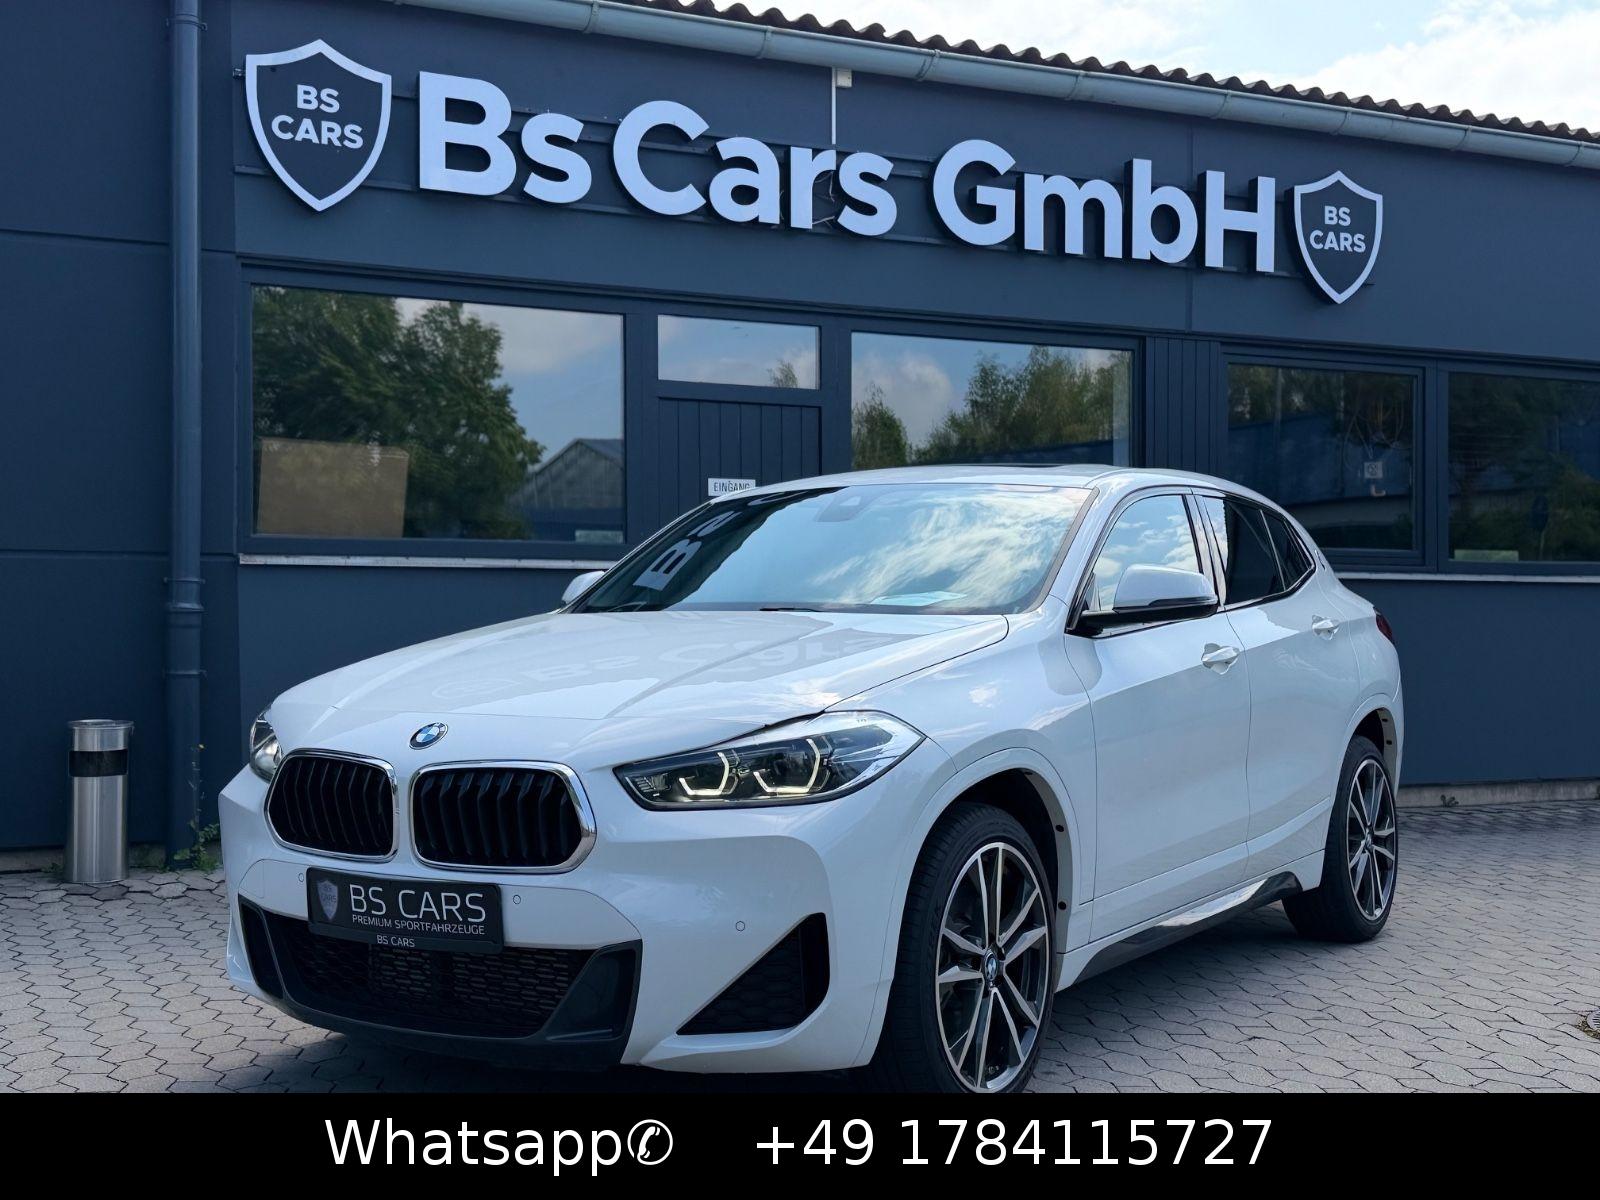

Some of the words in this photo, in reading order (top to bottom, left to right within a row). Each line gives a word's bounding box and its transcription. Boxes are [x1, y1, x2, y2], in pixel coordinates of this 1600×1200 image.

[296, 84, 340, 113] BS
[271, 114, 364, 149] CARS
[933, 139, 1276, 273] GmbH
[1324, 205, 1351, 227] BS
[1309, 229, 1366, 253] CARS
[713, 482, 751, 492] EINGANG
[349, 884, 387, 915] BS
[398, 889, 486, 923] CARS
[352, 914, 392, 928] PREMIUM
[395, 919, 485, 935] SPORTFAHRZEUGE
[376, 934, 389, 945] BS
[391, 936, 415, 948] CARS
